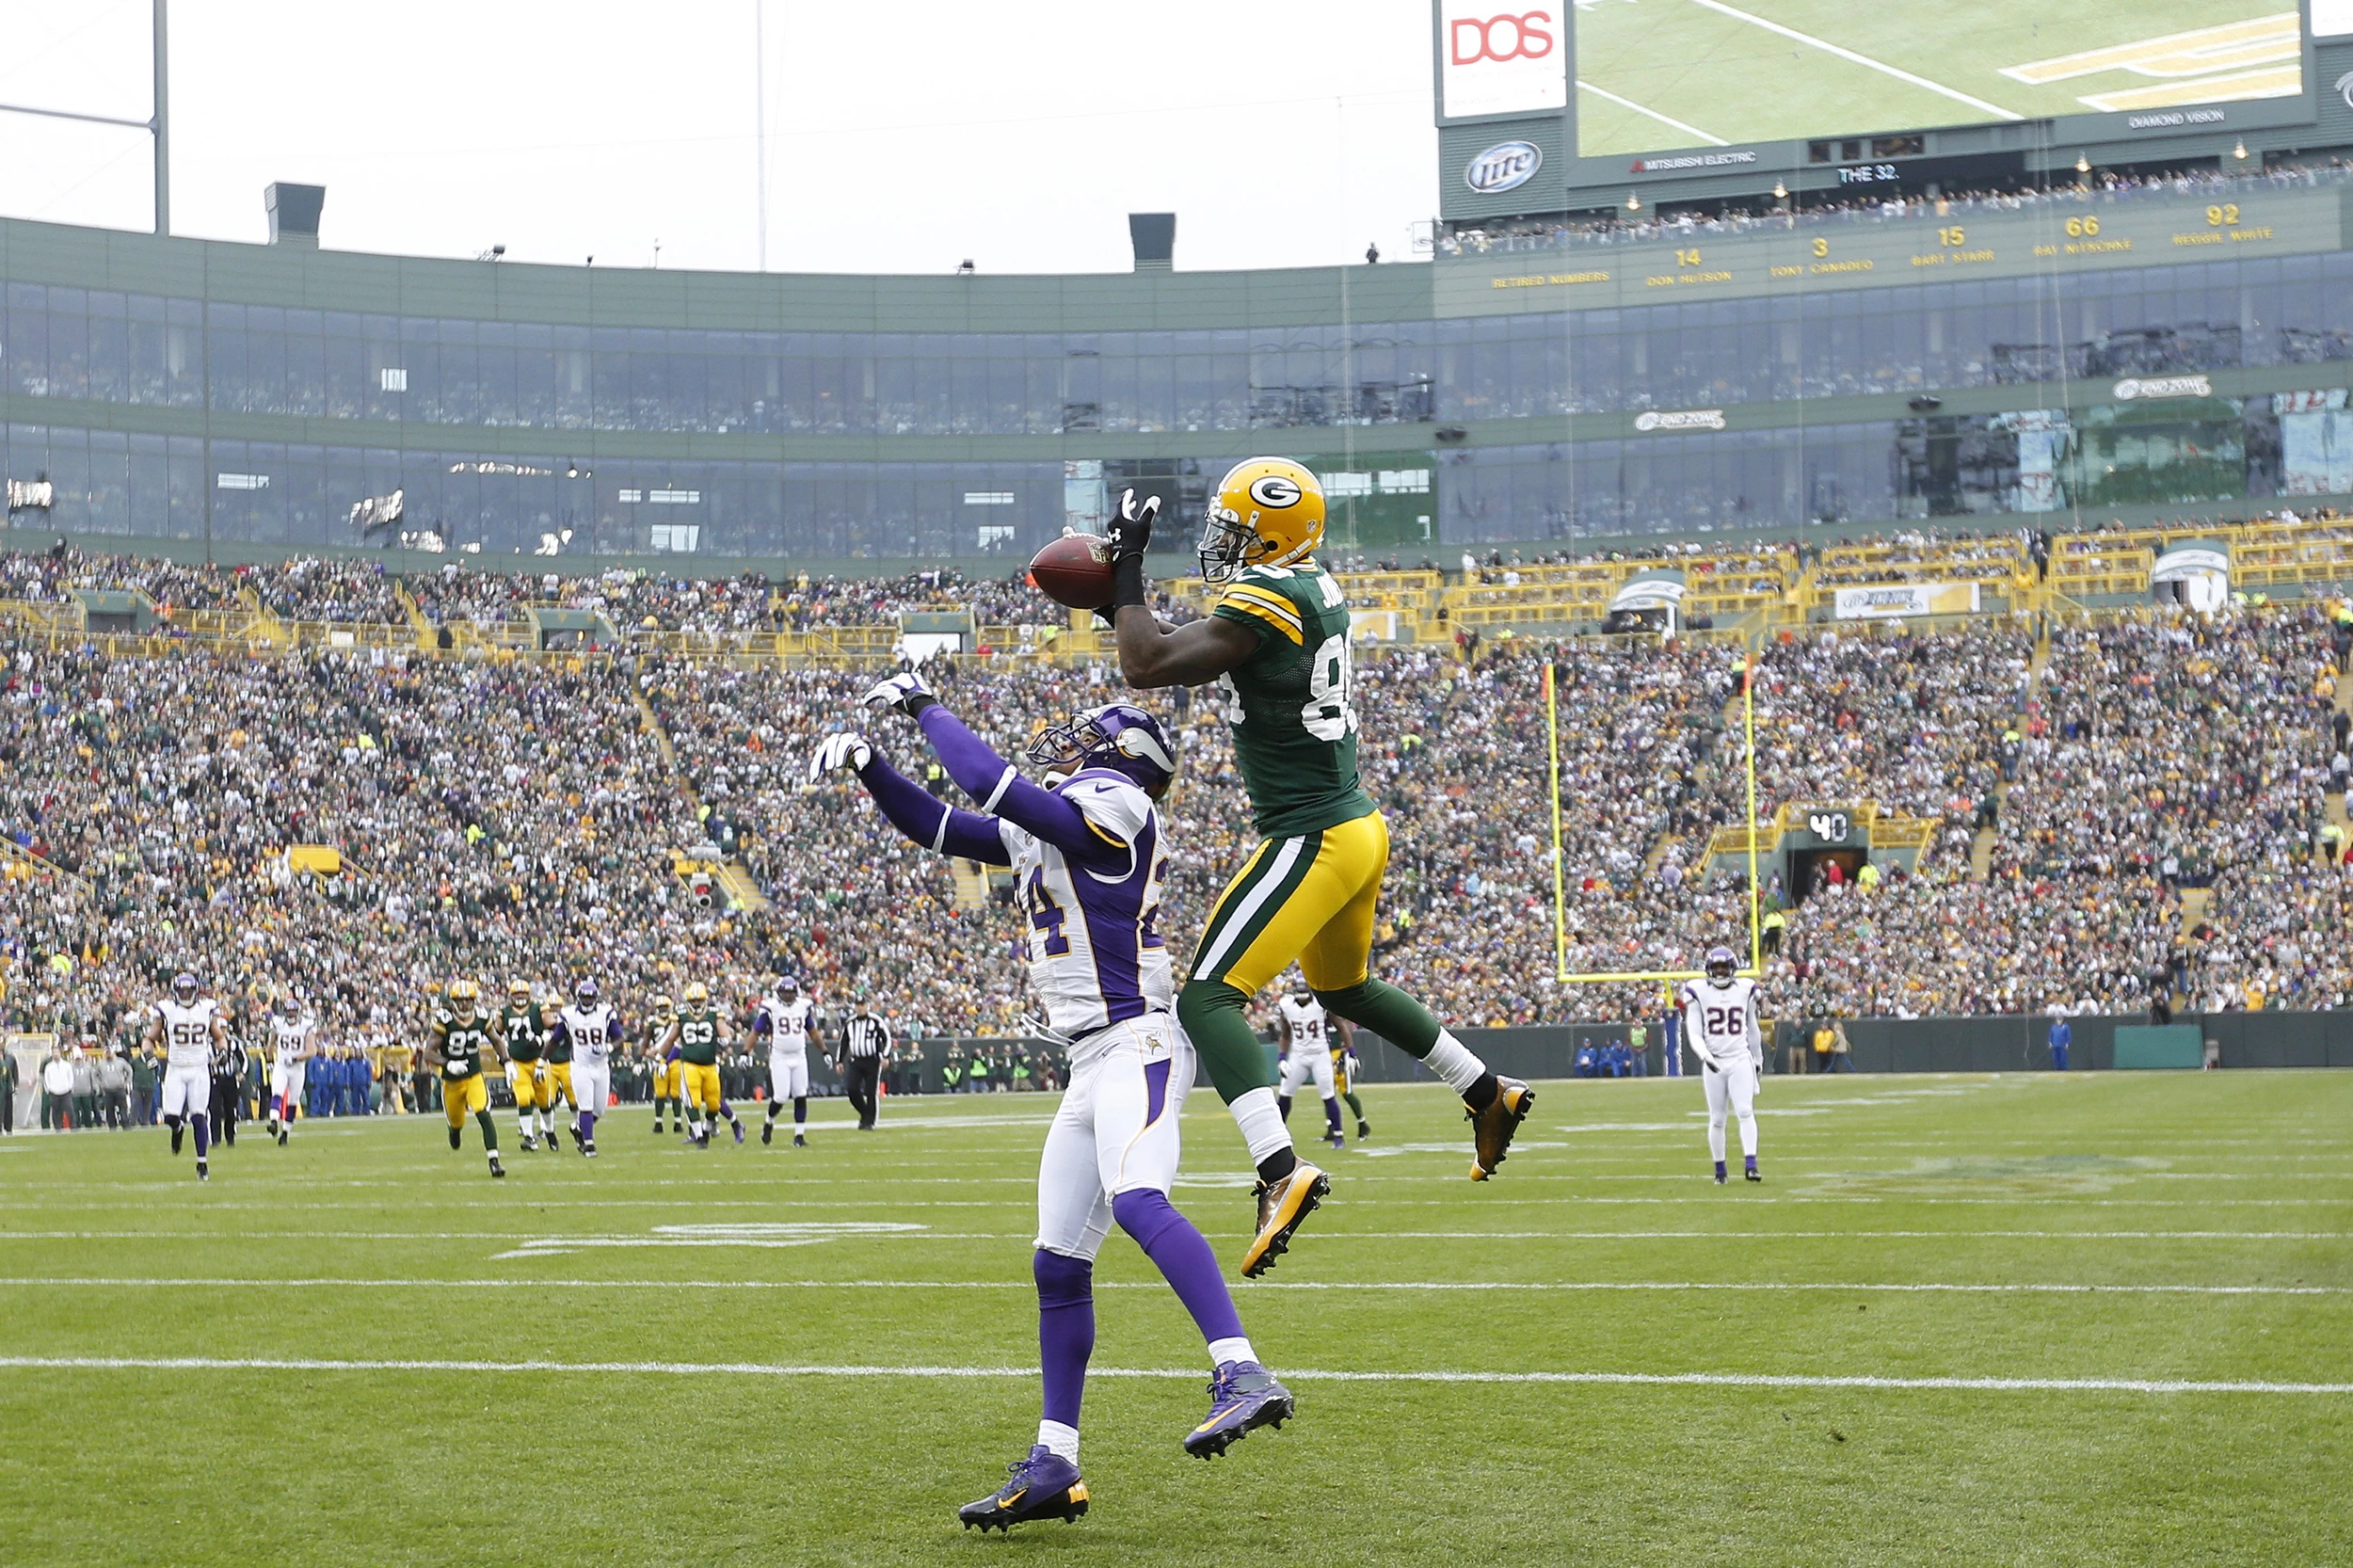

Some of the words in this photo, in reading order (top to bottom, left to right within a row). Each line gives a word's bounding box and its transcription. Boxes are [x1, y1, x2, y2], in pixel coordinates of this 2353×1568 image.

[1451, 10, 1553, 66] DOS
[2129, 113, 2185, 129] DIAMOND
[2185, 108, 2225, 124] VISION
[1644, 157, 1704, 170] MITSUBISHI
[1705, 151, 1756, 166] ELECTRIC
[1837, 166, 1873, 184] THE
[2206, 203, 2240, 226] 92
[1938, 226, 1965, 248] 15
[2066, 215, 2100, 238] 66
[2230, 226, 2274, 242] WHITE
[1675, 248, 1702, 267] 14
[1812, 237, 1829, 259] 3
[1493, 275, 1545, 289] RETIRED
[1549, 271, 1609, 285] NUMBERS
[1646, 276, 1674, 287] DON
[1679, 270, 1732, 284] HUTSON
[1769, 265, 1804, 278] TONY
[1302, 625, 1358, 742] 8
[1810, 813, 1848, 842] 40
[508, 1016, 536, 1041] 71
[778, 1016, 803, 1034] 93
[1290, 1019, 1319, 1040] 54
[1706, 1006, 1743, 1035] 26
[173, 1023, 206, 1044] 52
[280, 1035, 301, 1050] 69
[448, 1030, 483, 1056] 83
[575, 1028, 602, 1047] 98
[682, 1020, 713, 1045] 63
